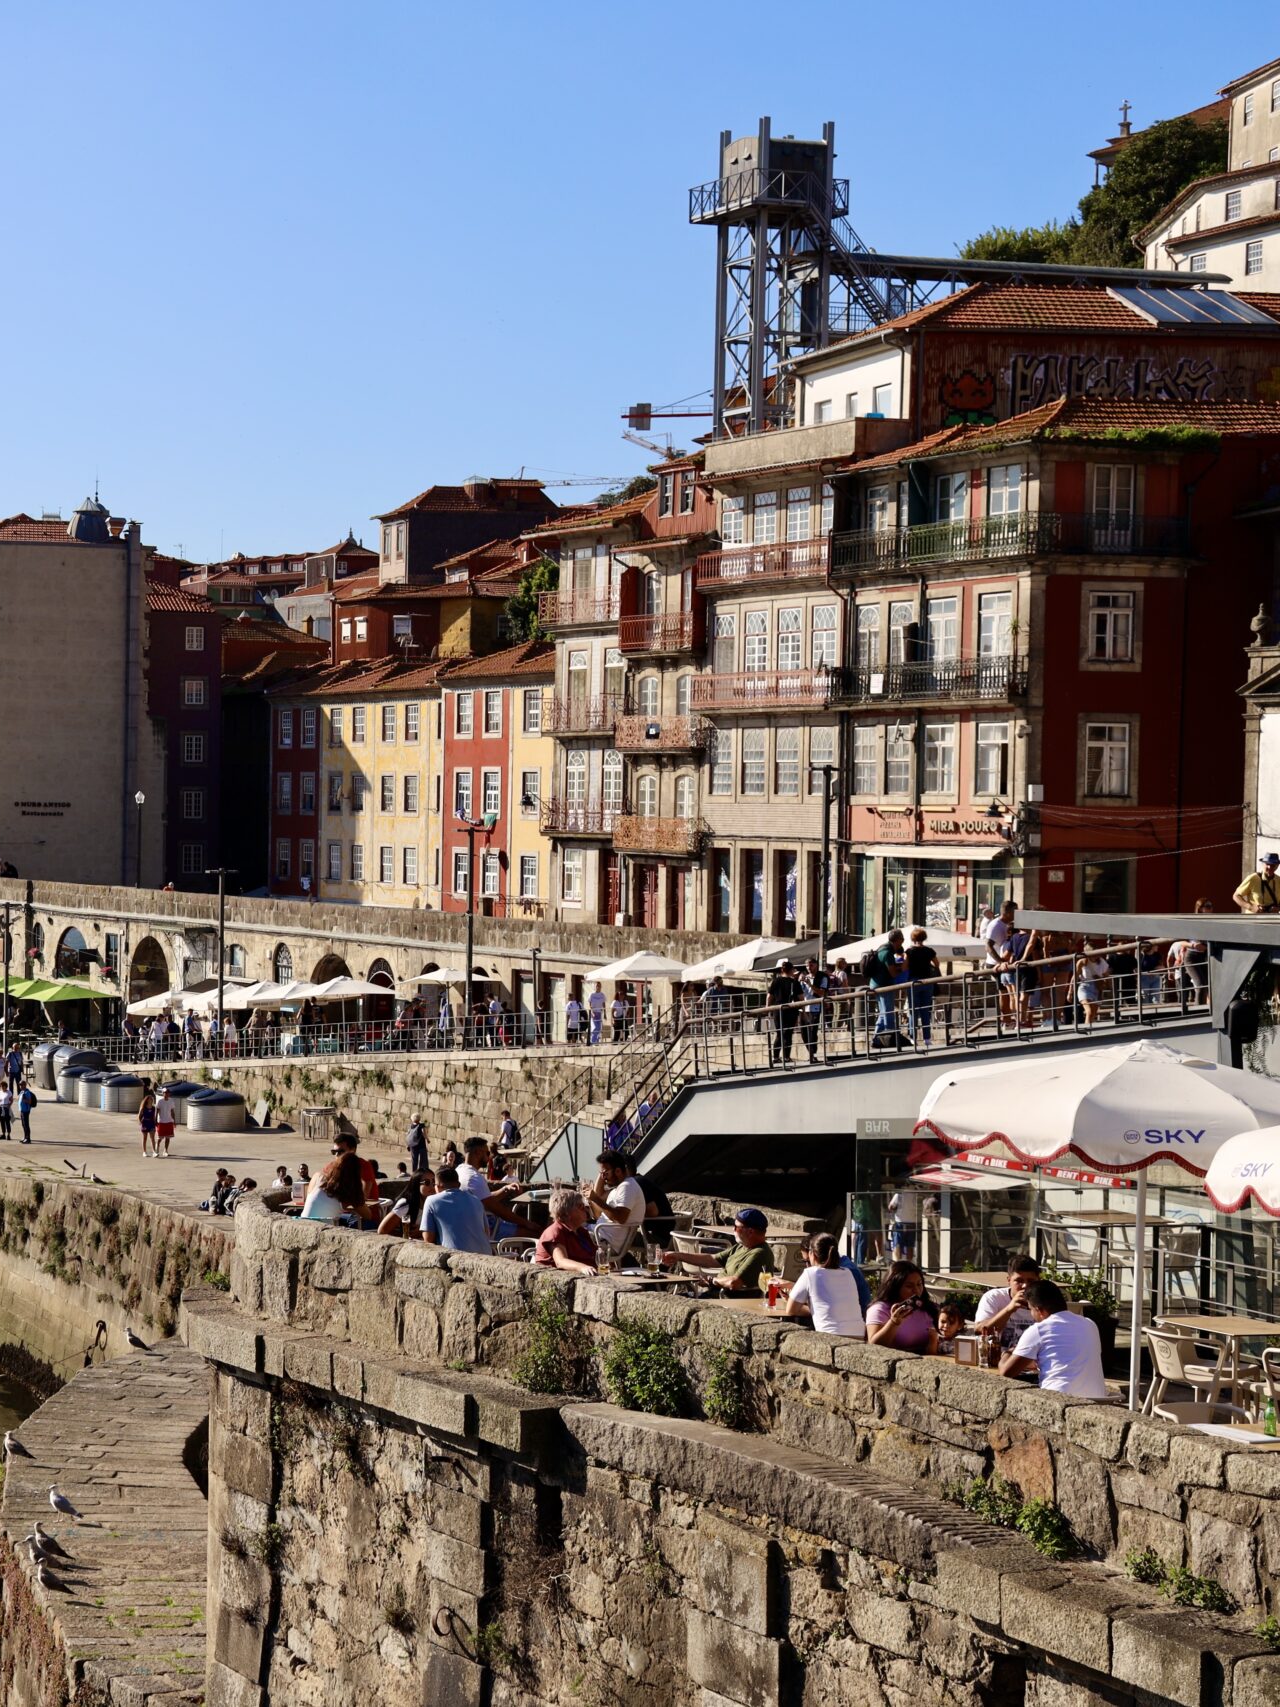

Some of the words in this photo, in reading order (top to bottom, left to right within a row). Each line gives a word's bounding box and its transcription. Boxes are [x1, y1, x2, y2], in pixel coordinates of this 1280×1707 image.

[929, 819, 954, 832] MIRA
[959, 819, 997, 833] DOURO
[1144, 1129, 1206, 1144] SKY
[967, 1153, 985, 1164] RENT
[990, 1157, 1008, 1169] BIKE
[1056, 1170, 1079, 1180] RENT
[1093, 1175, 1114, 1186] BIKE
[1240, 1163, 1274, 1178] SKY
